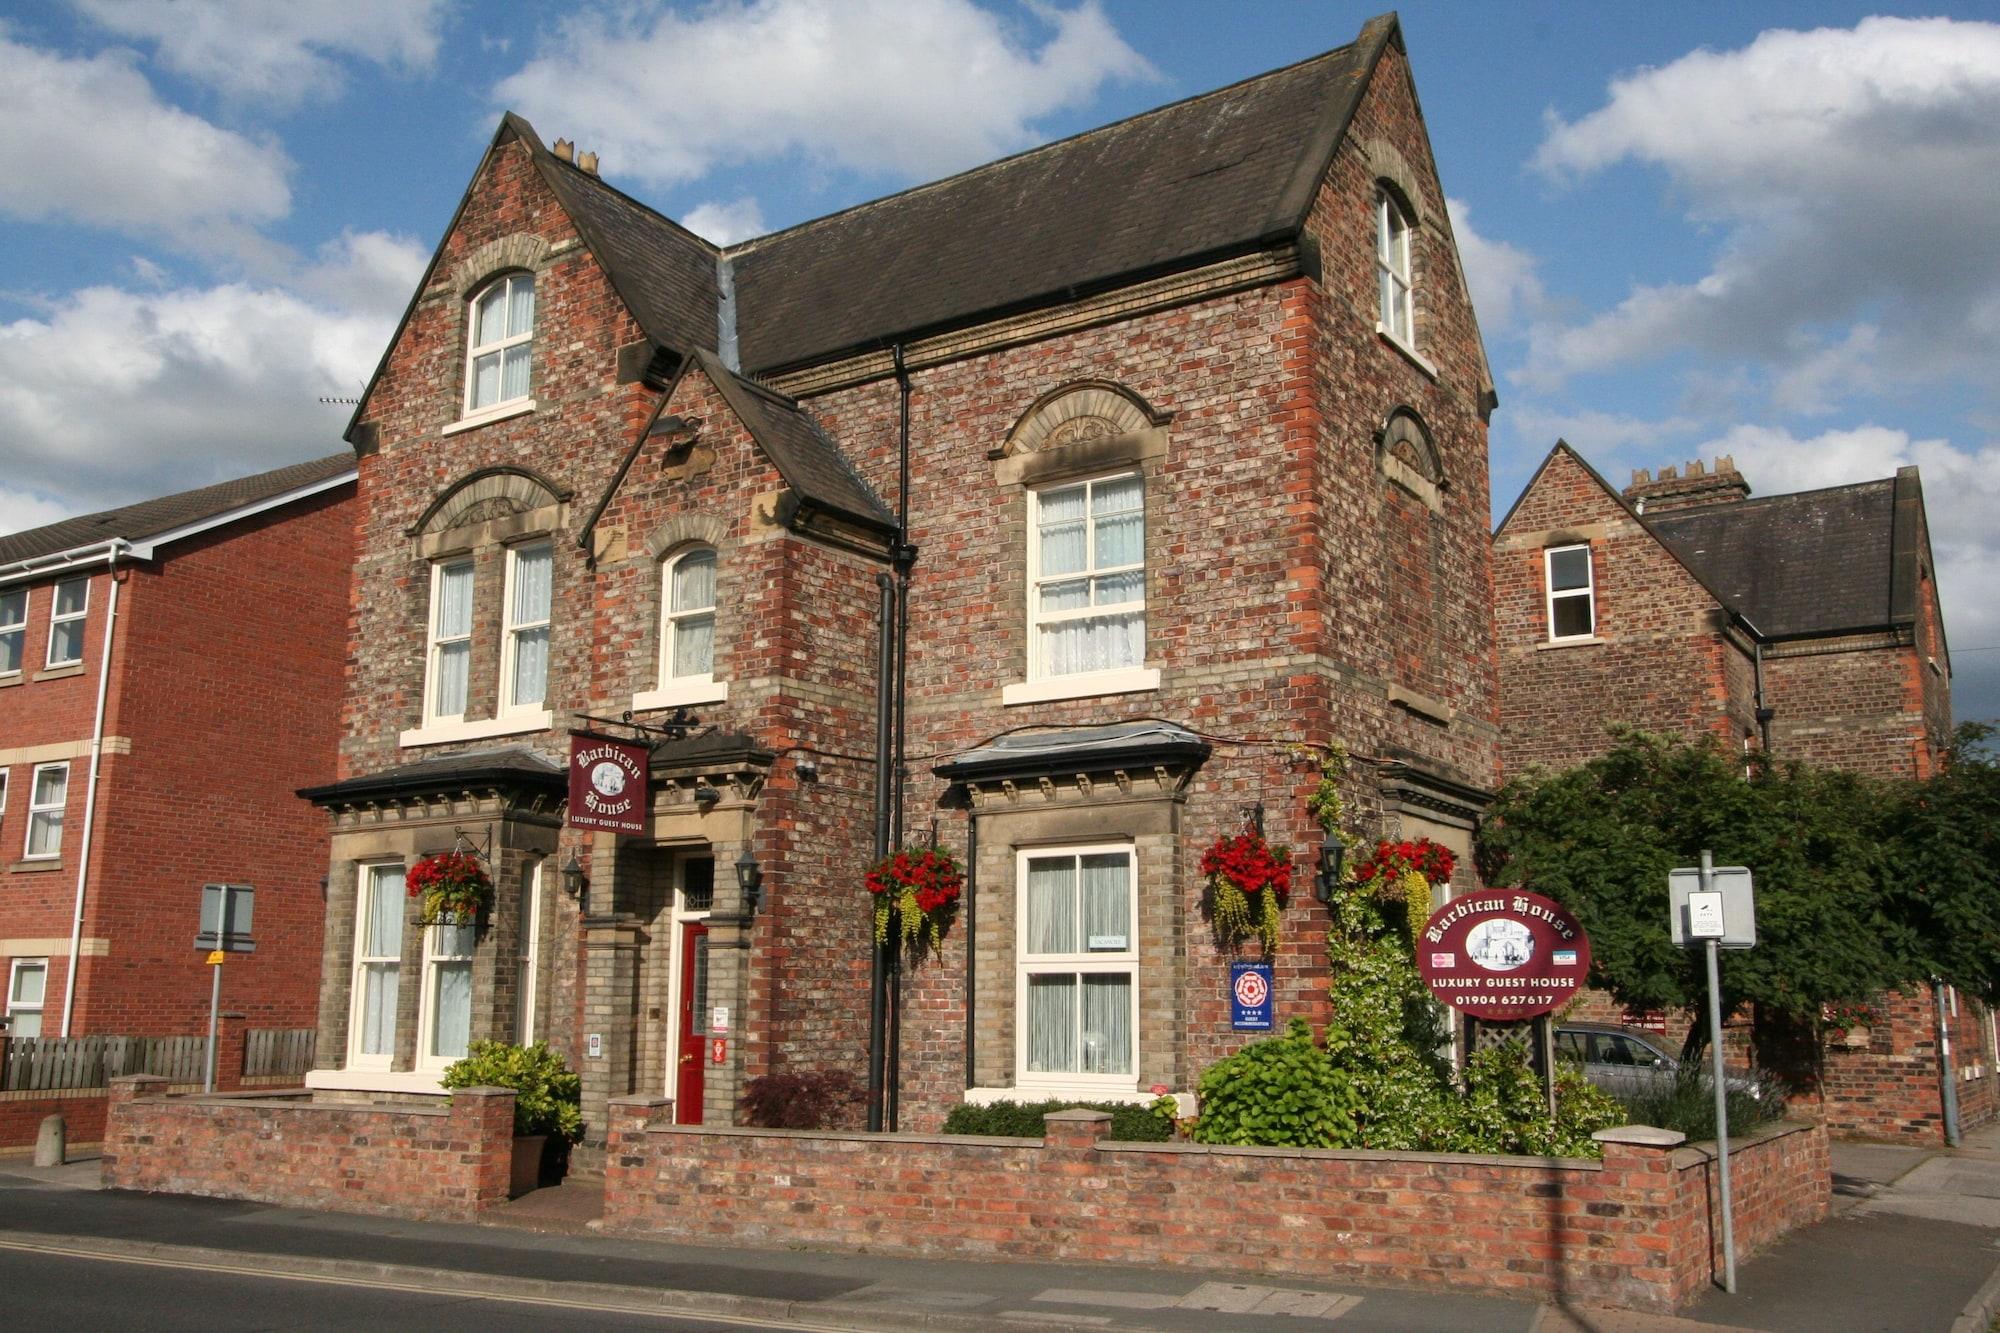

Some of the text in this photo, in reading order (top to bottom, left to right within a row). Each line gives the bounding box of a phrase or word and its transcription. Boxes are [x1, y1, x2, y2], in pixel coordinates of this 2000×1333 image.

[576, 744, 641, 779] Barbican
[585, 791, 631, 815] House
[571, 815, 642, 831] LUXURY GUEST HOUSE
[1426, 896, 1574, 944] Barbican House
[1432, 978, 1575, 988] LUXURY GUEST HOUSE
[1456, 995, 1553, 1005] 01904 627617
